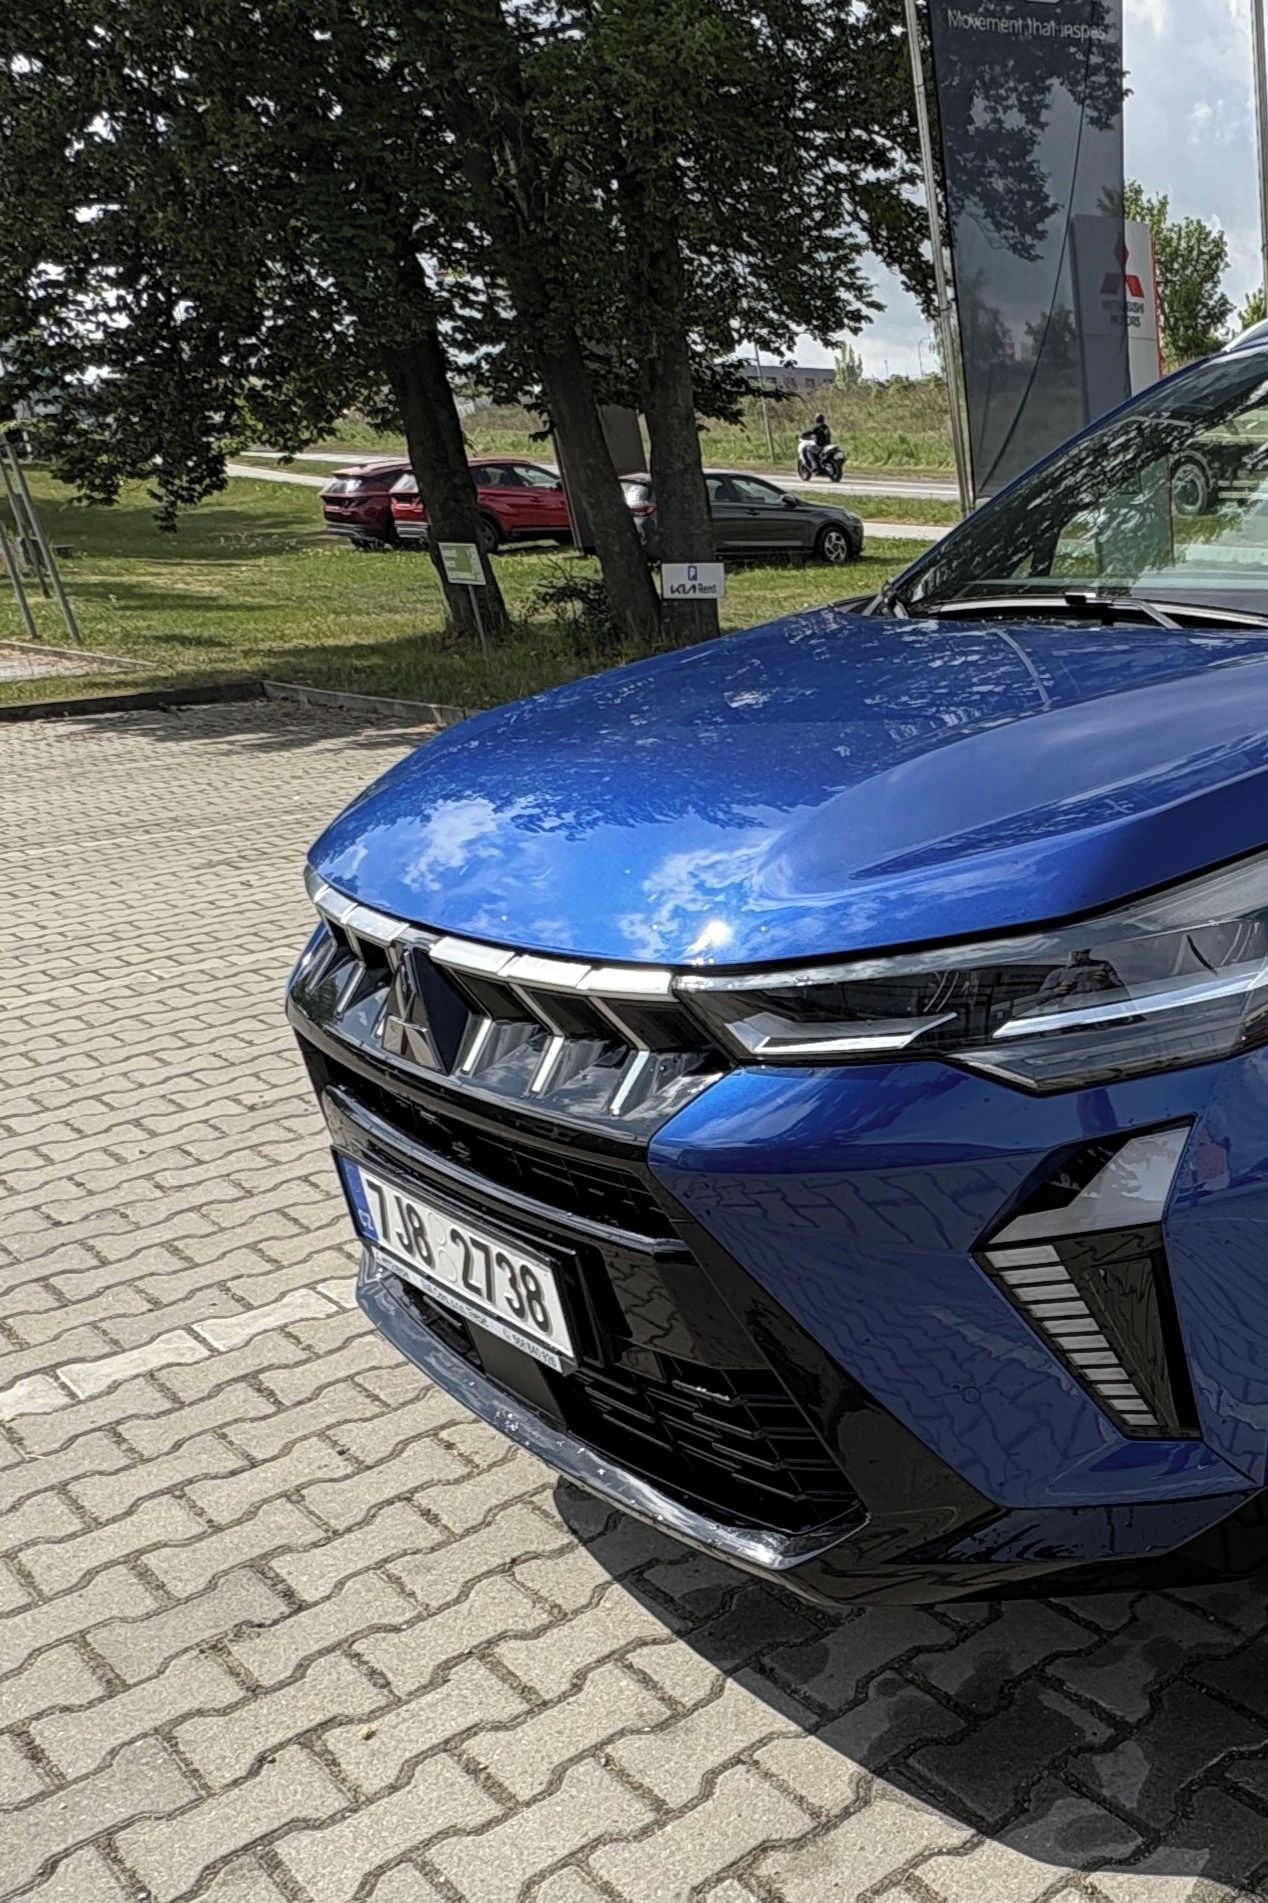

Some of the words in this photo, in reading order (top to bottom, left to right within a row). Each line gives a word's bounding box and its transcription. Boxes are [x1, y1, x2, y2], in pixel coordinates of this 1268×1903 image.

[947, 9, 1023, 34] Movement
[1026, 18, 1056, 37] that
[670, 583, 697, 595] KIA
[697, 583, 717, 594] Rent
[358, 1208, 374, 1230] CZ
[366, 1178, 435, 1267] 7J8
[450, 1228, 553, 1333] 2738
